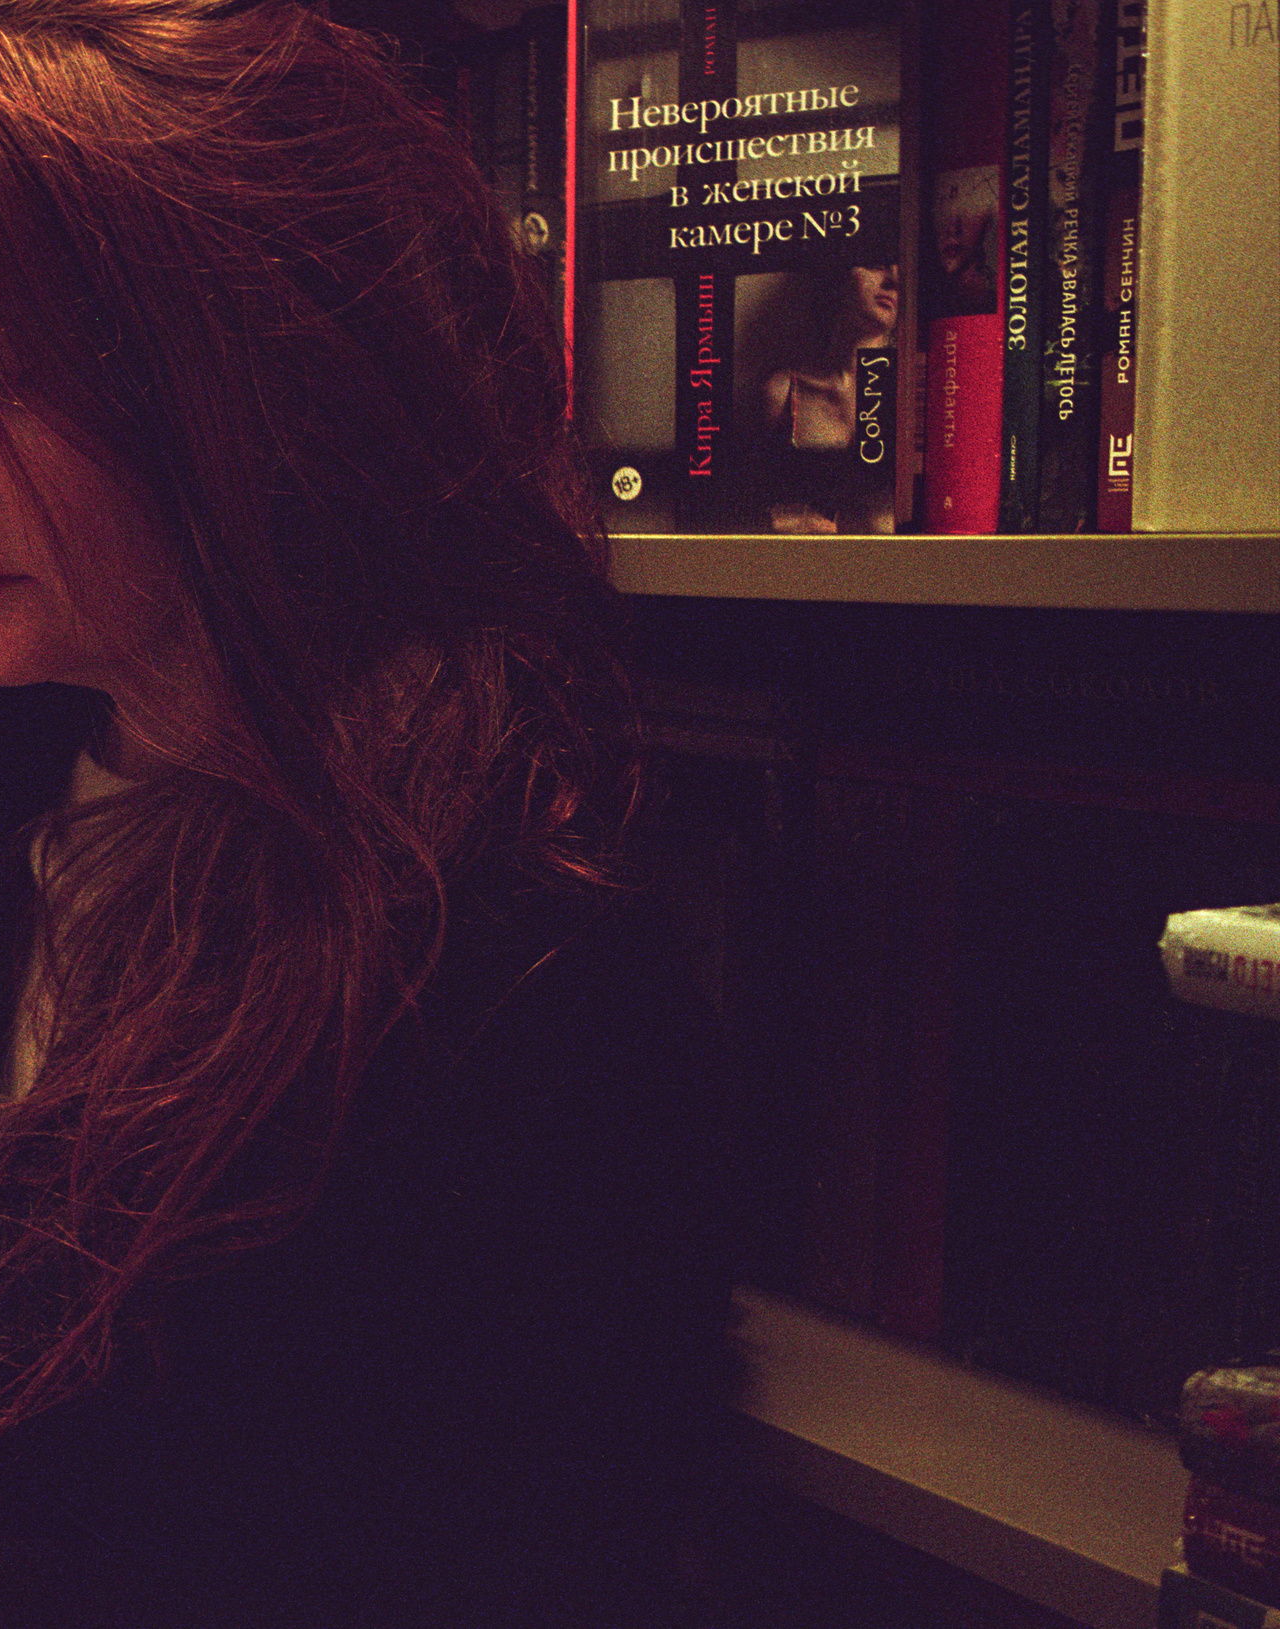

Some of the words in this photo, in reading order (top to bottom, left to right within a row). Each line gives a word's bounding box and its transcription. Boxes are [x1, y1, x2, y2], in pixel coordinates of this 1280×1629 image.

[1231, 1, 1280, 49] ПА
[609, 84, 859, 133] Невероятные
[1011, 8, 1037, 212] САЛАМАНДРА
[609, 126, 875, 181] происшествия
[670, 185, 689, 207] в
[702, 159, 861, 205] женской
[670, 218, 793, 254] камере
[801, 205, 860, 239] №3
[1062, 208, 1079, 266] РЕЧКА
[1121, 218, 1135, 302] СЕНЧИН
[1008, 218, 1029, 351] ЗОЛОТАЯ
[1060, 269, 1077, 348] ЗВАЛАСЬ
[690, 273, 721, 390] Ярмыш
[1117, 310, 1132, 384] РОМАН
[943, 331, 960, 448] артефакты
[1058, 353, 1075, 420] ЛЕТОСЬ
[689, 399, 720, 477] Кира
[614, 475, 639, 494] 18+
